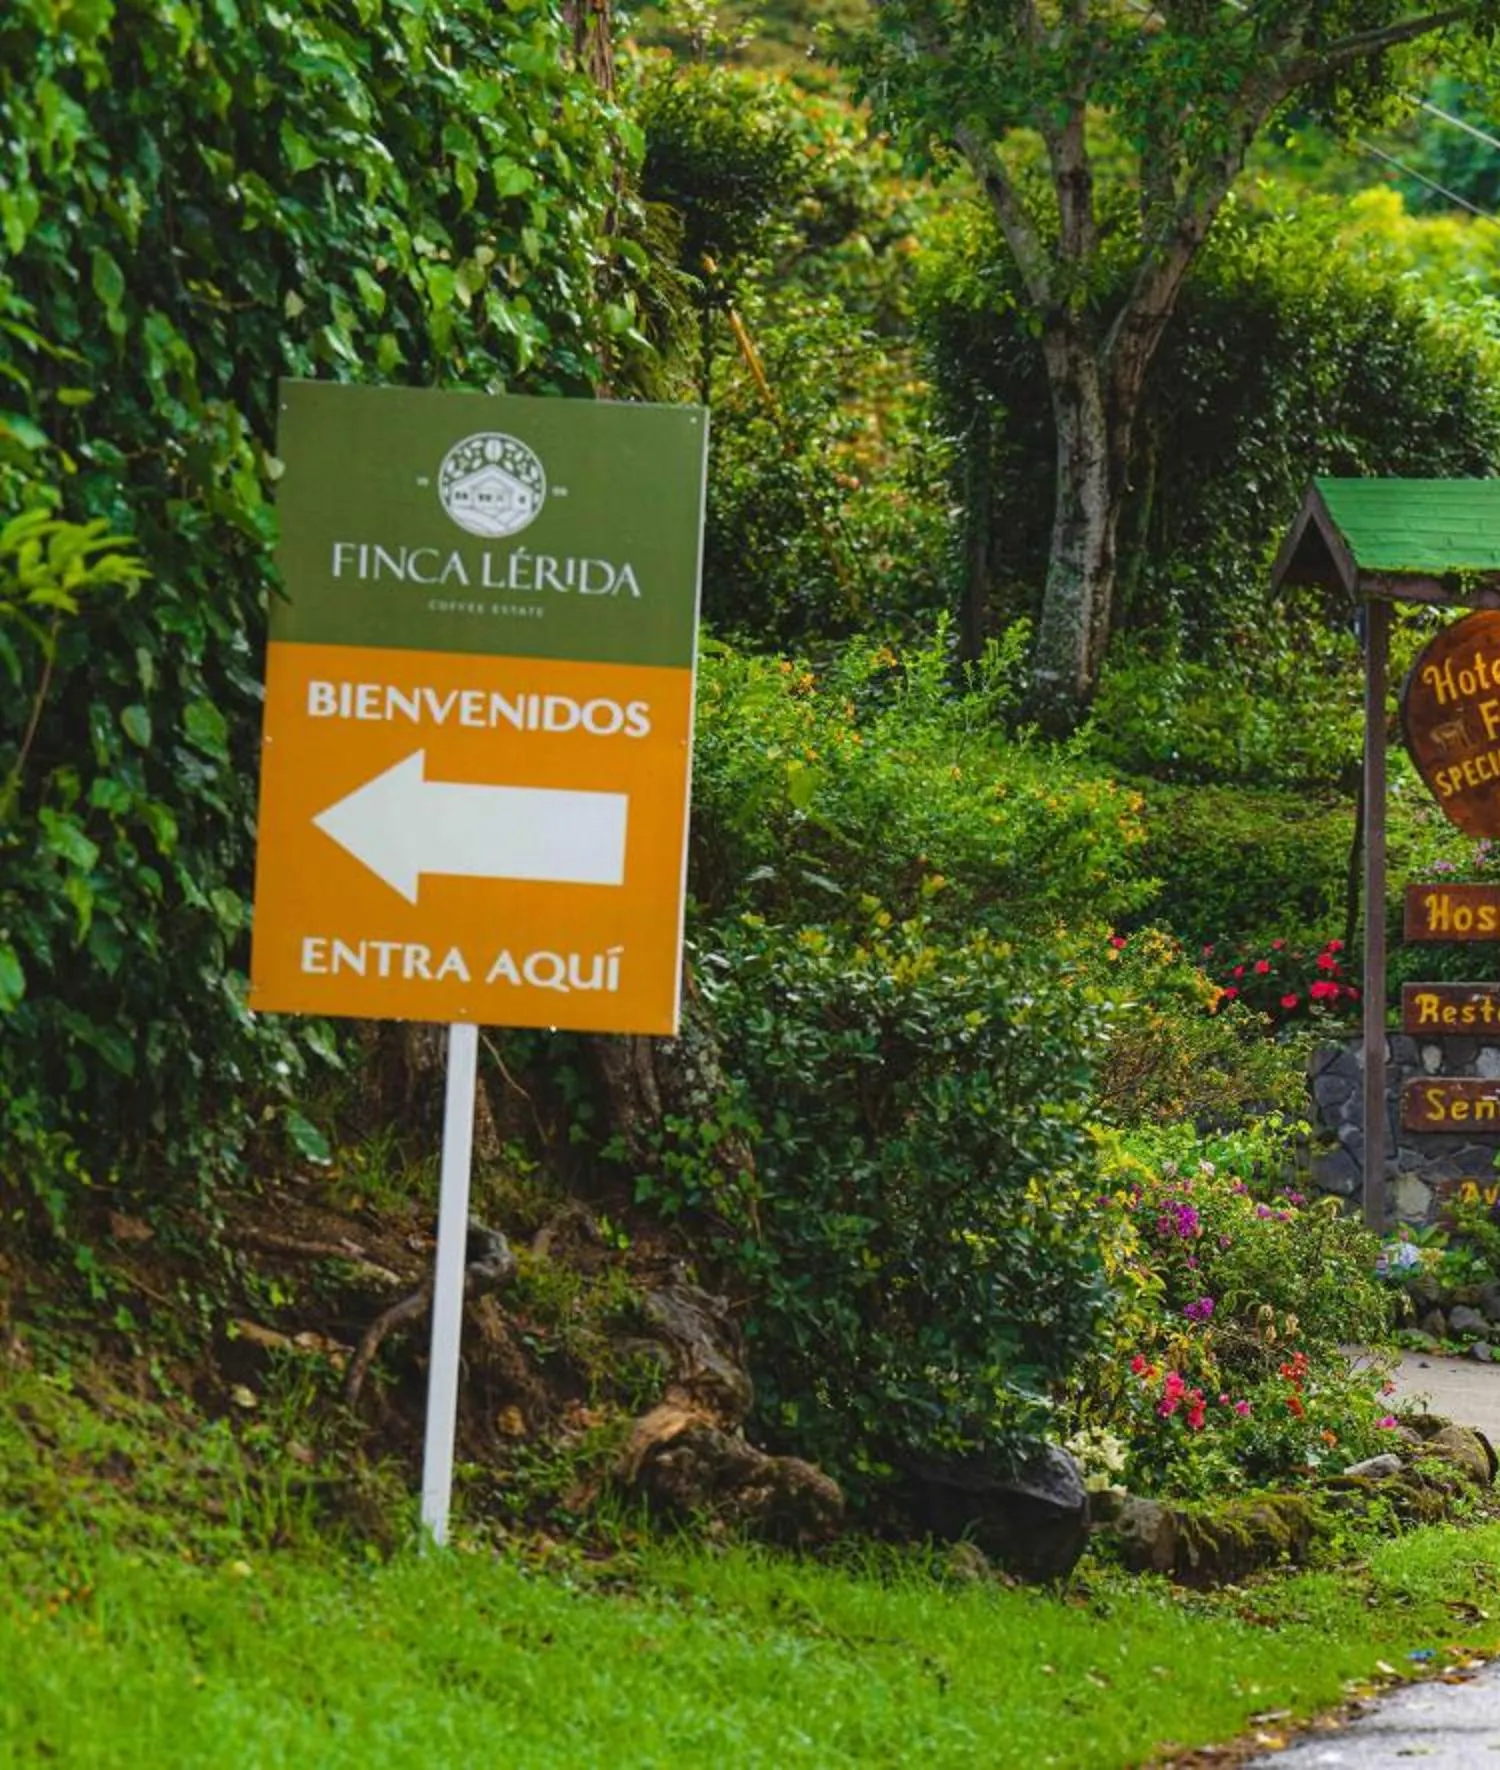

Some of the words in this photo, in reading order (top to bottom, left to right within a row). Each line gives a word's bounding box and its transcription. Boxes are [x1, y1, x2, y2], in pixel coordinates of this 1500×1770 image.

[332, 541, 468, 586] FINCA
[481, 546, 641, 598] LÉRIDA
[491, 603, 544, 618] ESTATE
[307, 680, 651, 738] BIENVENIDOS
[300, 936, 470, 983] ENTRA
[485, 945, 625, 993] AQUÍ
